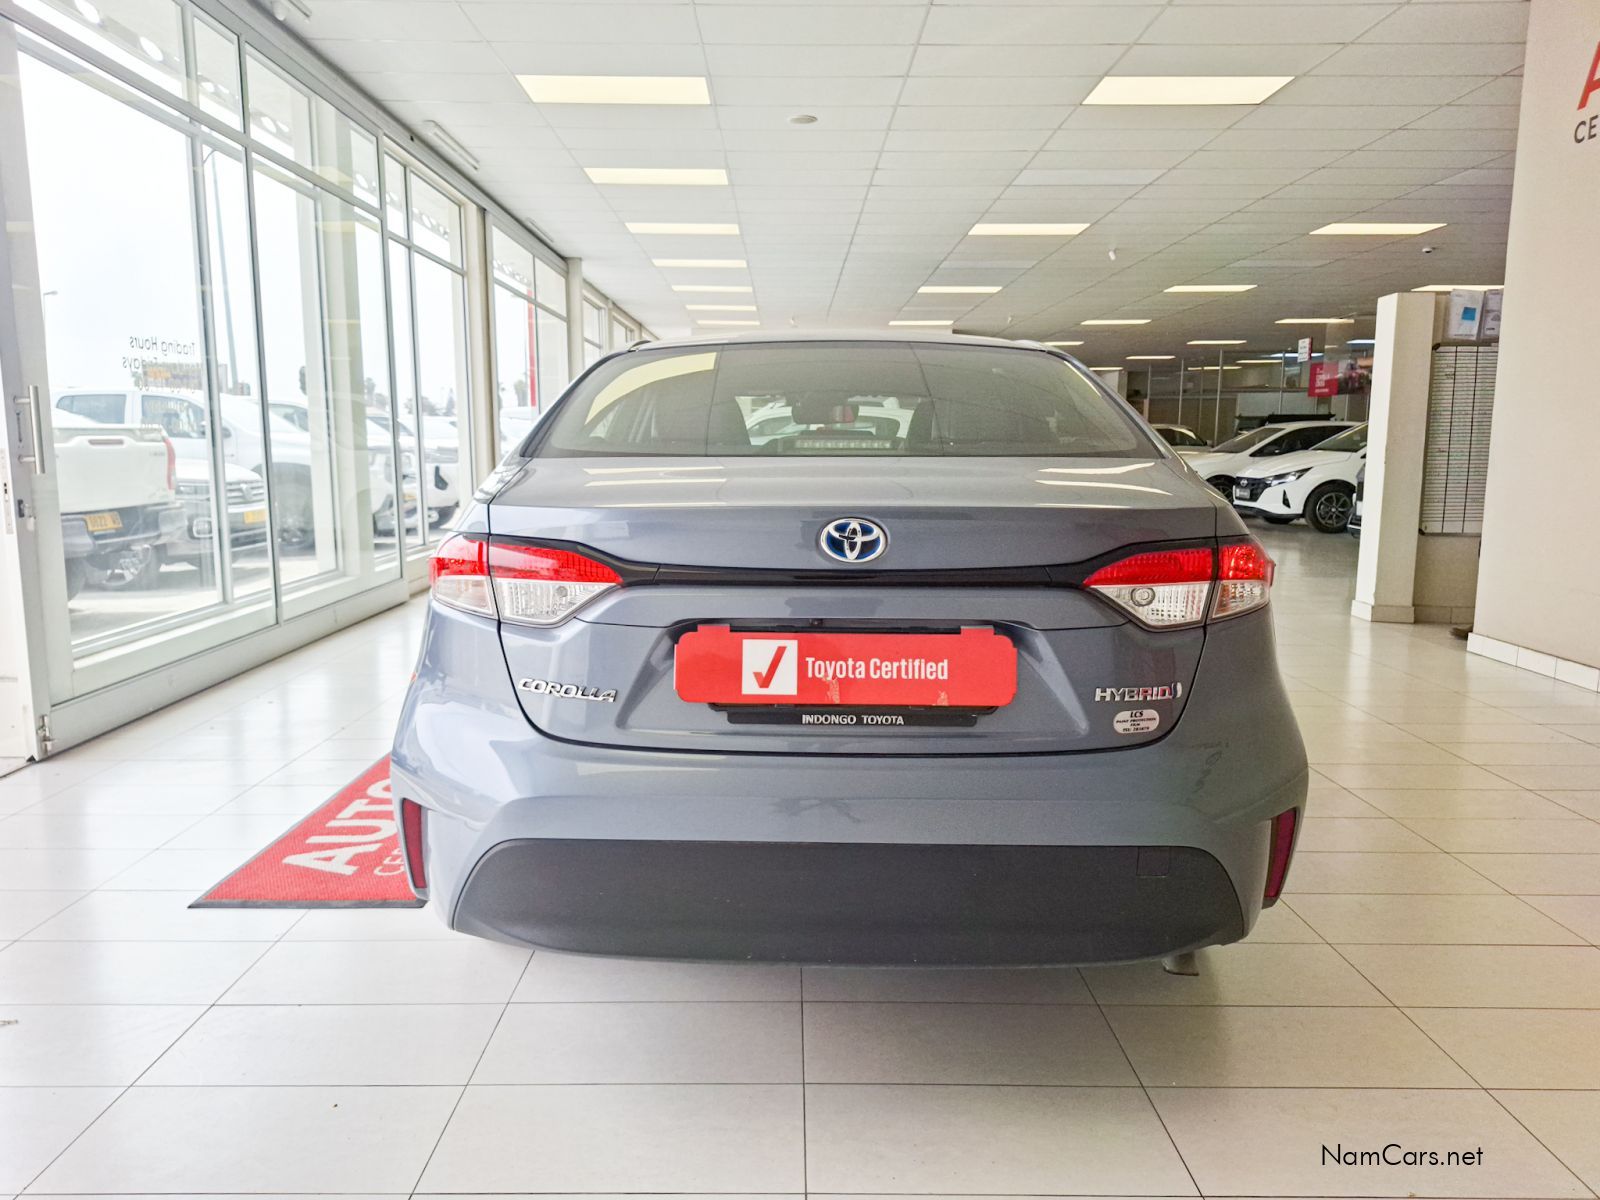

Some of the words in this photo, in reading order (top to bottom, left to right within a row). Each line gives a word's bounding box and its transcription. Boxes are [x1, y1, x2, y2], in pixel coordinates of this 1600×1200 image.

[805, 657, 866, 680] Toyota
[869, 658, 949, 680] Certified
[518, 678, 618, 703] COROLLA
[1094, 686, 1173, 702] HYBRID
[801, 714, 857, 725] INDONGO
[861, 715, 905, 725] TOYOTA
